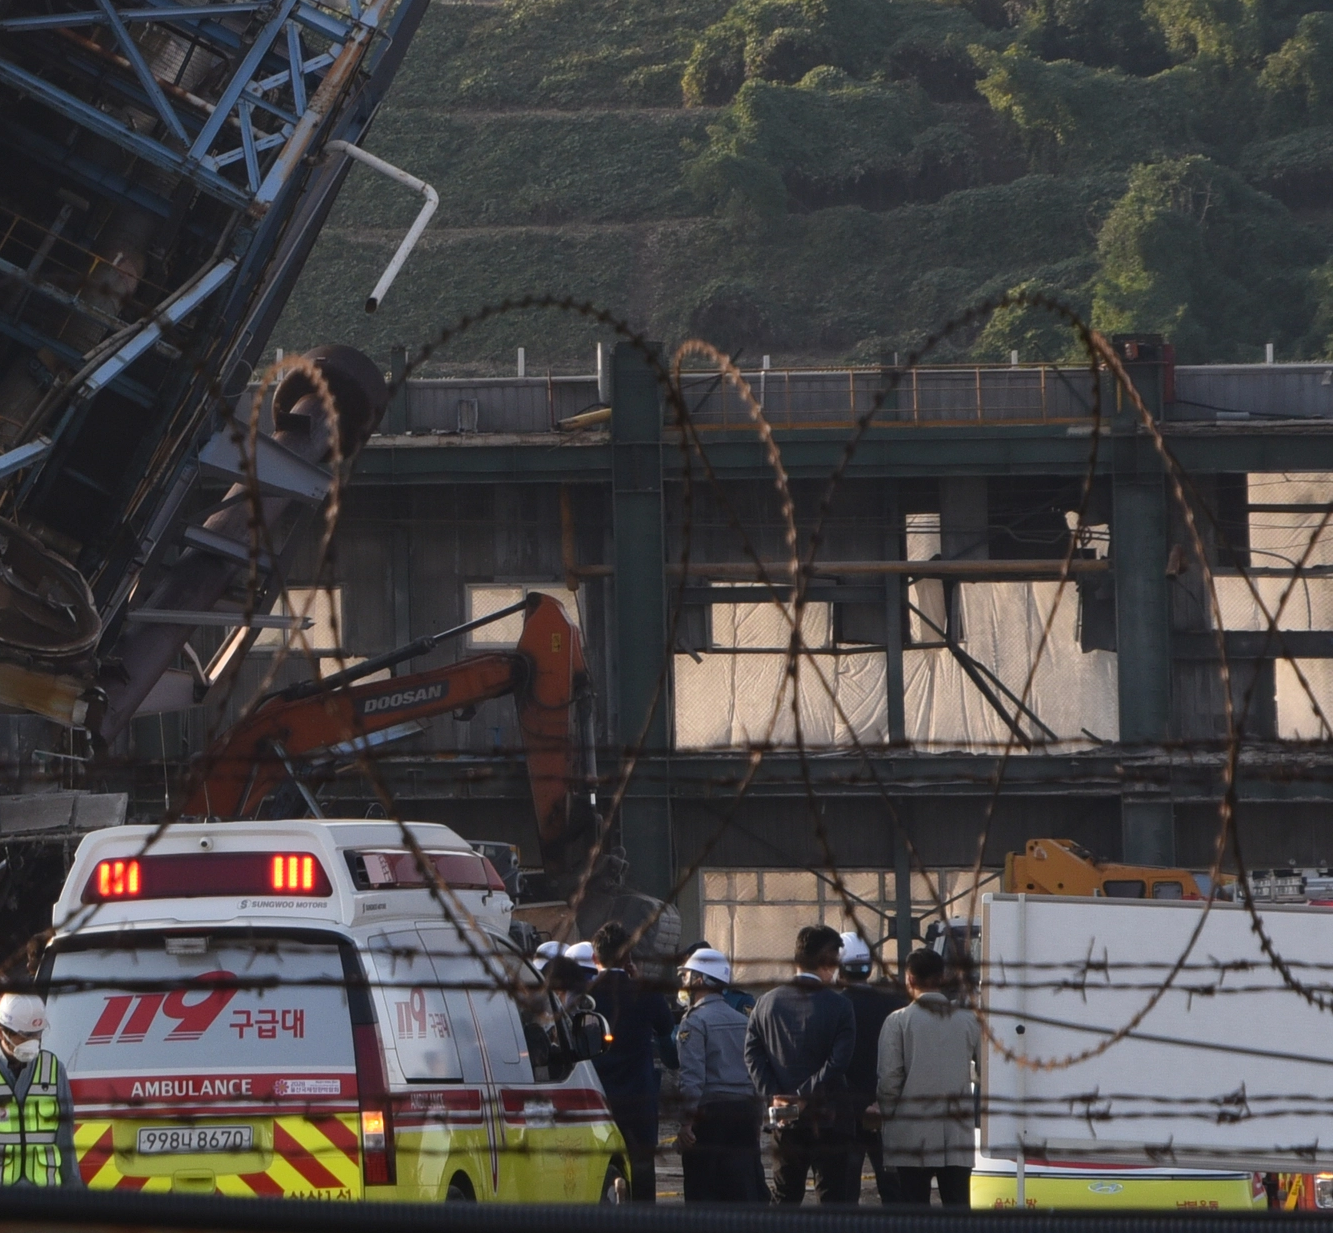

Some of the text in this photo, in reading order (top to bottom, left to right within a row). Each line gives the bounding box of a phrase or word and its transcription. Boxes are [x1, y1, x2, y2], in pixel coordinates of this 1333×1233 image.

[364, 684, 442, 713] DOOSAN
[251, 900, 294, 909] SUNGWOO
[296, 900, 328, 909] MOTORS
[85, 971, 305, 1045] 119 구급대
[394, 987, 427, 1039] 119
[130, 1078, 253, 1098] AMBULANCE
[196, 1130, 244, 1149] 8670
[994, 1197, 1038, 1210] 울산방
